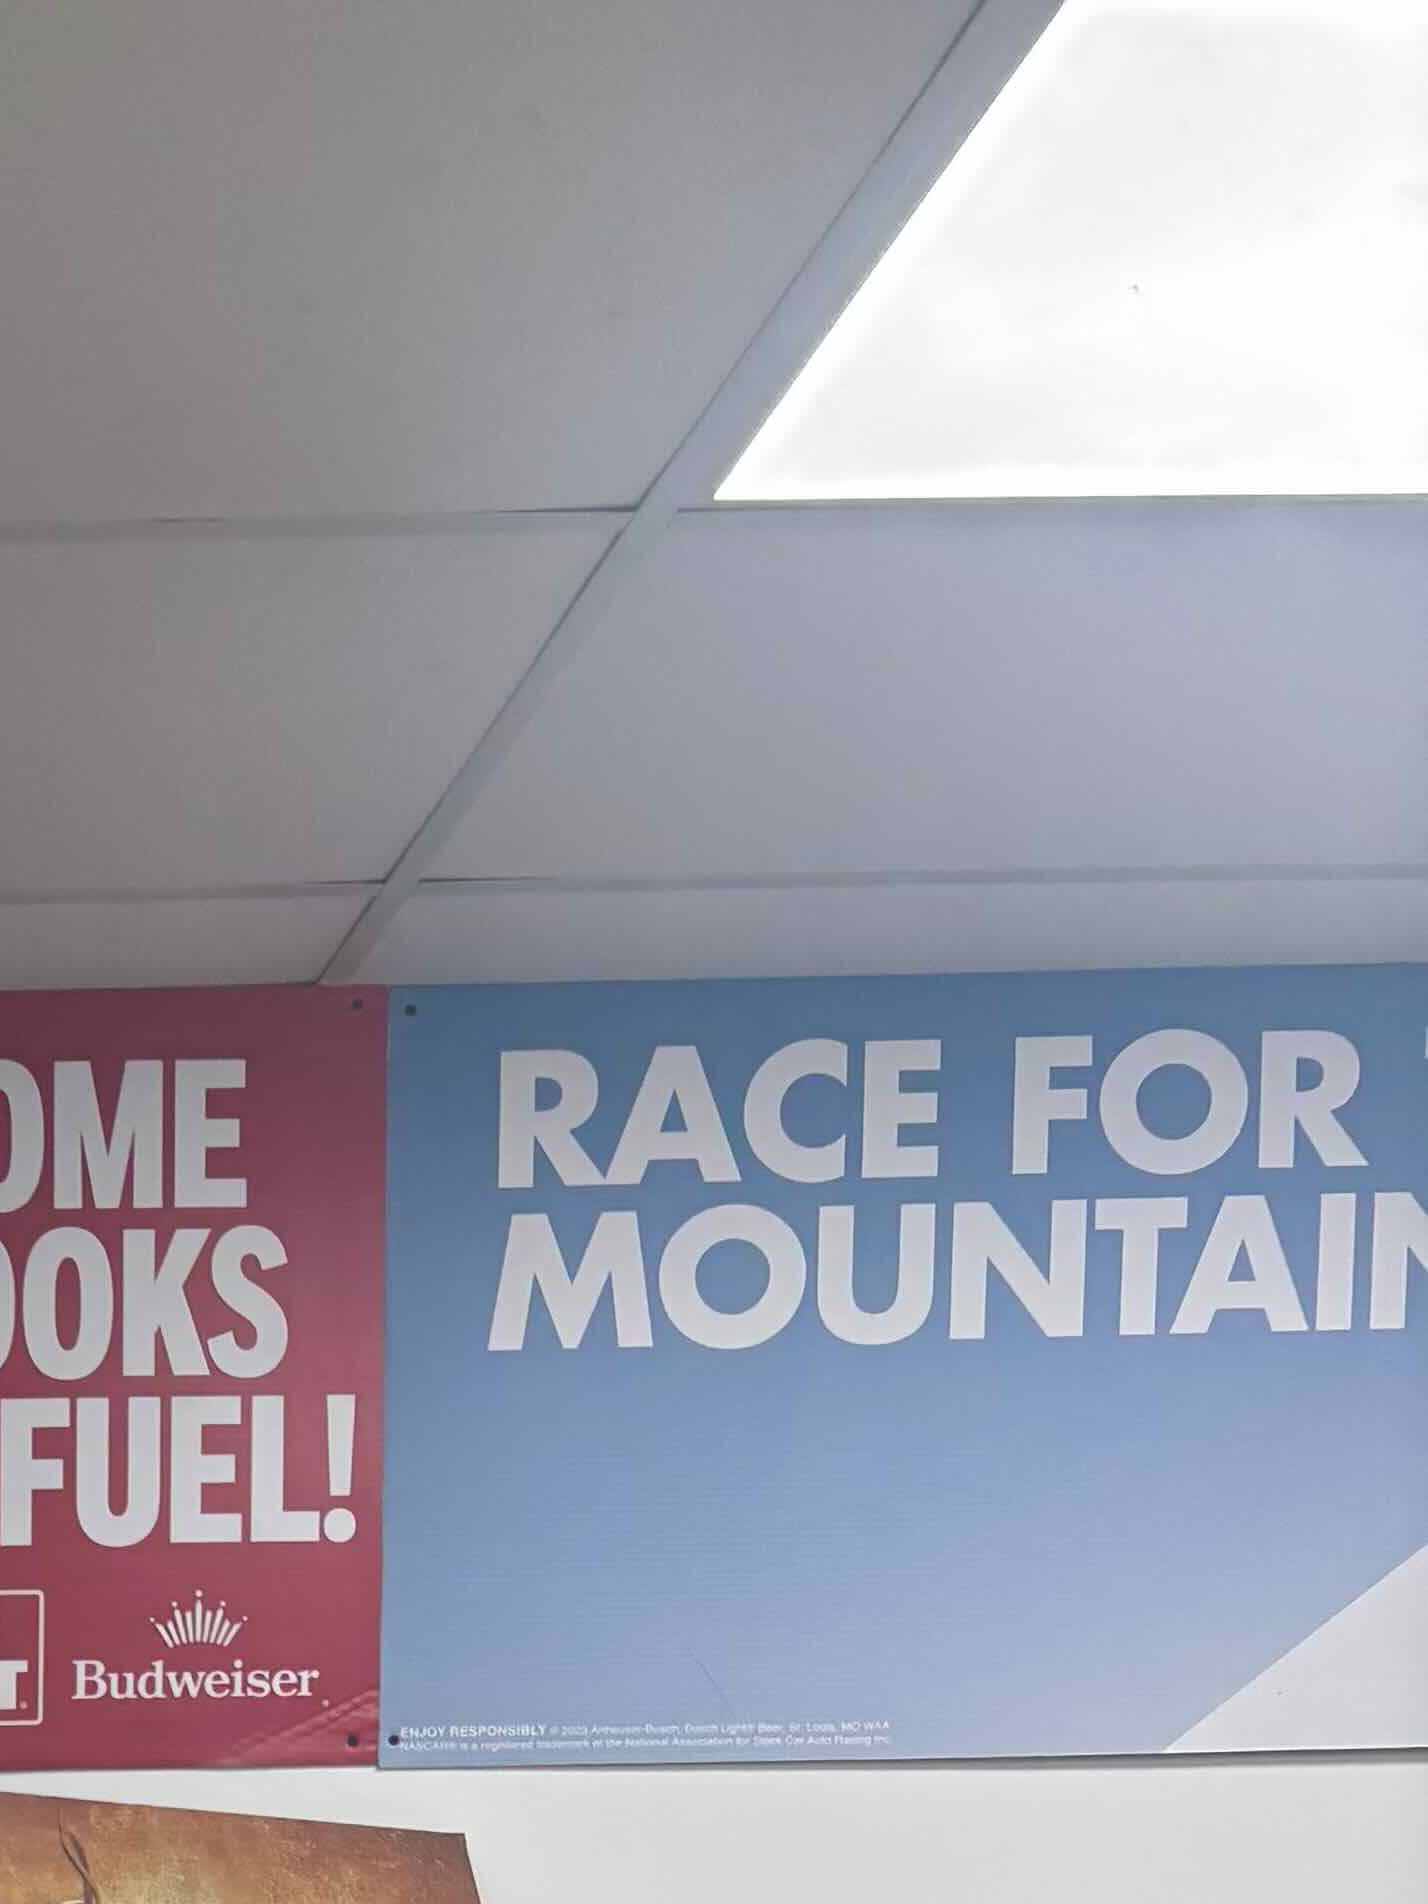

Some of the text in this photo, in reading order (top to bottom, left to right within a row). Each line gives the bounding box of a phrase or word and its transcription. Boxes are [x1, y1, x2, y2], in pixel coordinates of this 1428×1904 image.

[499, 1028, 1368, 1188] RACE FOR
[0, 1394, 357, 1548] FUEL!
[71, 1660, 319, 1702] Budweiser
[400, 1727, 445, 1738] ENJOY
[450, 1725, 545, 1737] RESPONSIBLY
